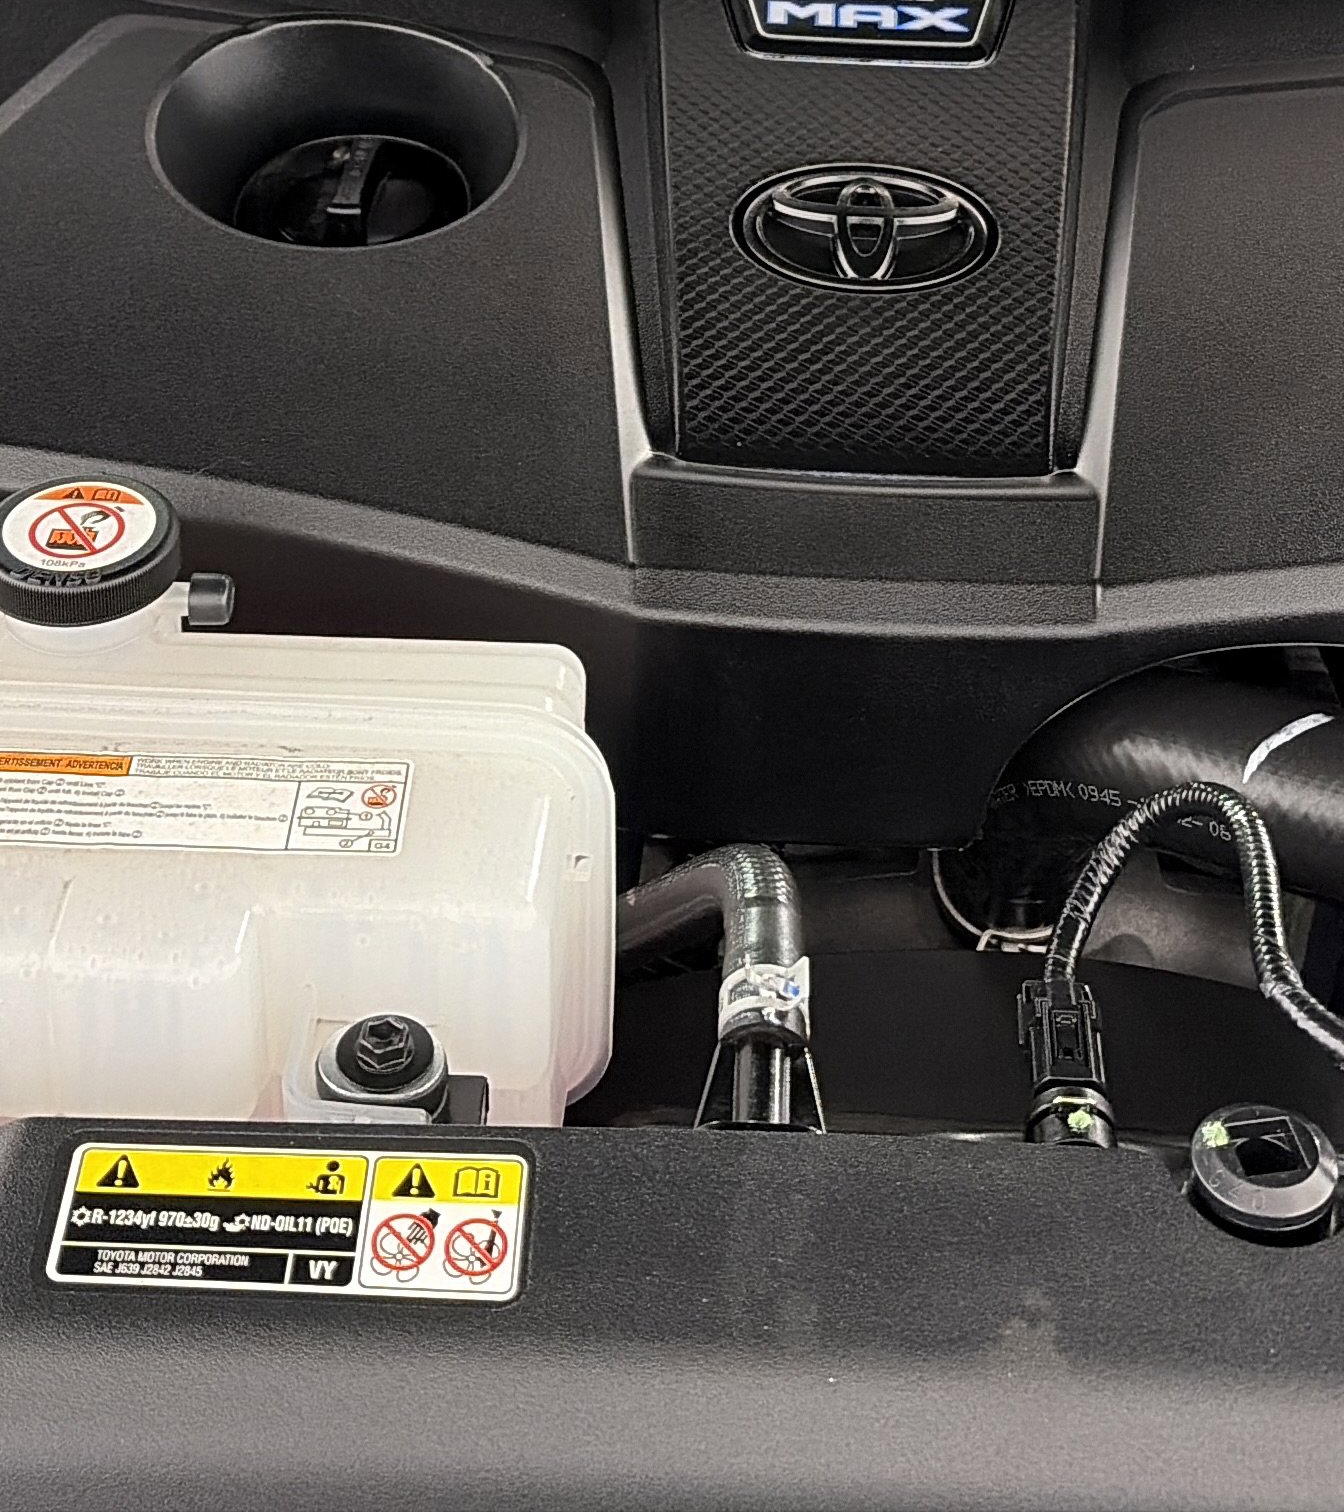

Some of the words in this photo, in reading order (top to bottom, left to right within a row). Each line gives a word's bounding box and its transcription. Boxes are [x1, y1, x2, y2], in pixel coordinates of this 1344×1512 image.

[766, 0, 970, 33] MAX
[65, 758, 125, 771] ADVERTENCIA
[90, 1208, 158, 1230] R-1234yf
[158, 1210, 219, 1232] 970±30g
[314, 1216, 353, 1237] (POE)
[93, 1261, 113, 1274] SAE
[114, 1262, 140, 1275] J639
[97, 1249, 136, 1262] TOYOTA
[137, 1251, 175, 1264] MOTOR
[176, 1252, 250, 1267] CORPORATION
[308, 1259, 338, 1281] VY
